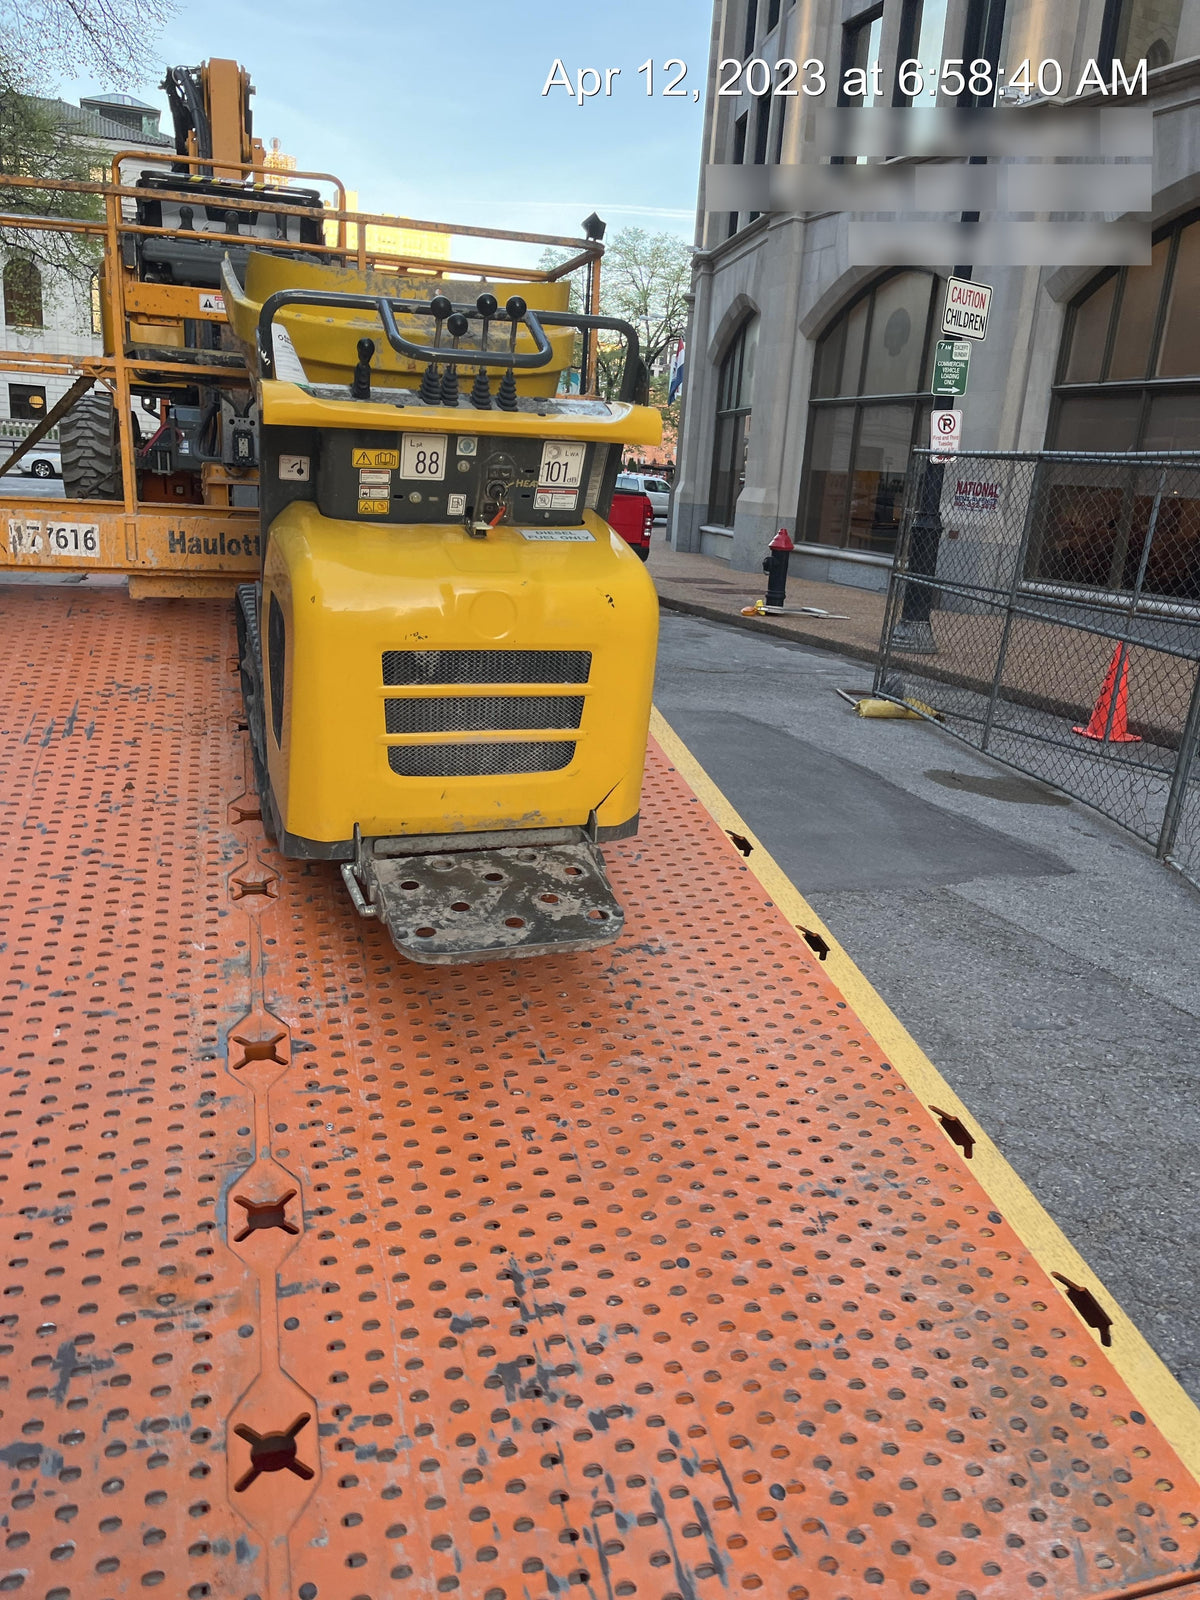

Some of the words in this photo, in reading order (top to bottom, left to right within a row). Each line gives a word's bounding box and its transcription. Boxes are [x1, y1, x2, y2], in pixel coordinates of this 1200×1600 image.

[952, 286, 986, 310] CAUTION
[946, 308, 986, 332] CHILDREN
[416, 451, 439, 475] 88
[545, 461, 569, 483] 101
[956, 480, 999, 498] NATIONAL
